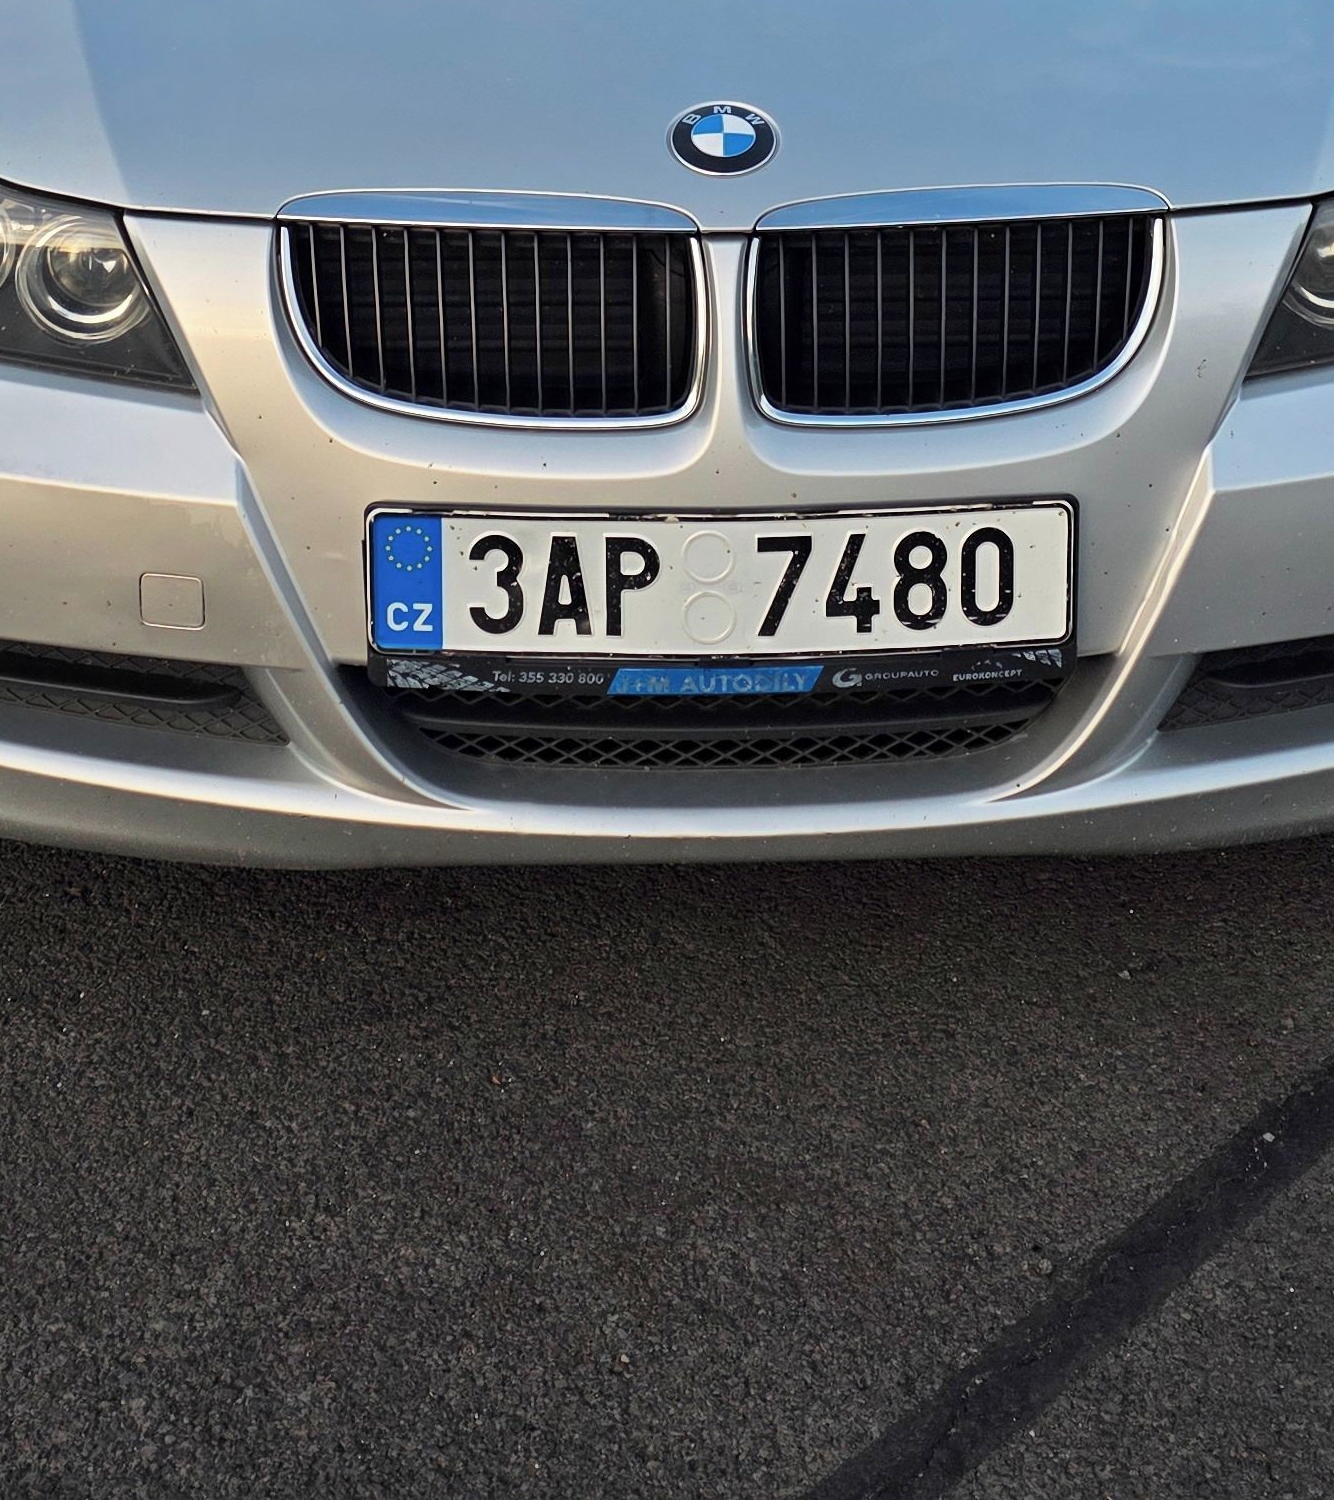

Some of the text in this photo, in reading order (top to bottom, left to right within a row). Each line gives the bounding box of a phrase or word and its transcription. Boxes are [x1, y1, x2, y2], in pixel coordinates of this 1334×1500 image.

[682, 105, 765, 125] BMW
[467, 526, 1014, 638] 3AP 7480
[385, 601, 434, 632] CZ
[492, 670, 604, 685] Tel: 355 330 800
[864, 669, 940, 681] GROUPAUTO
[952, 668, 1023, 682] EUROKONCEPT
